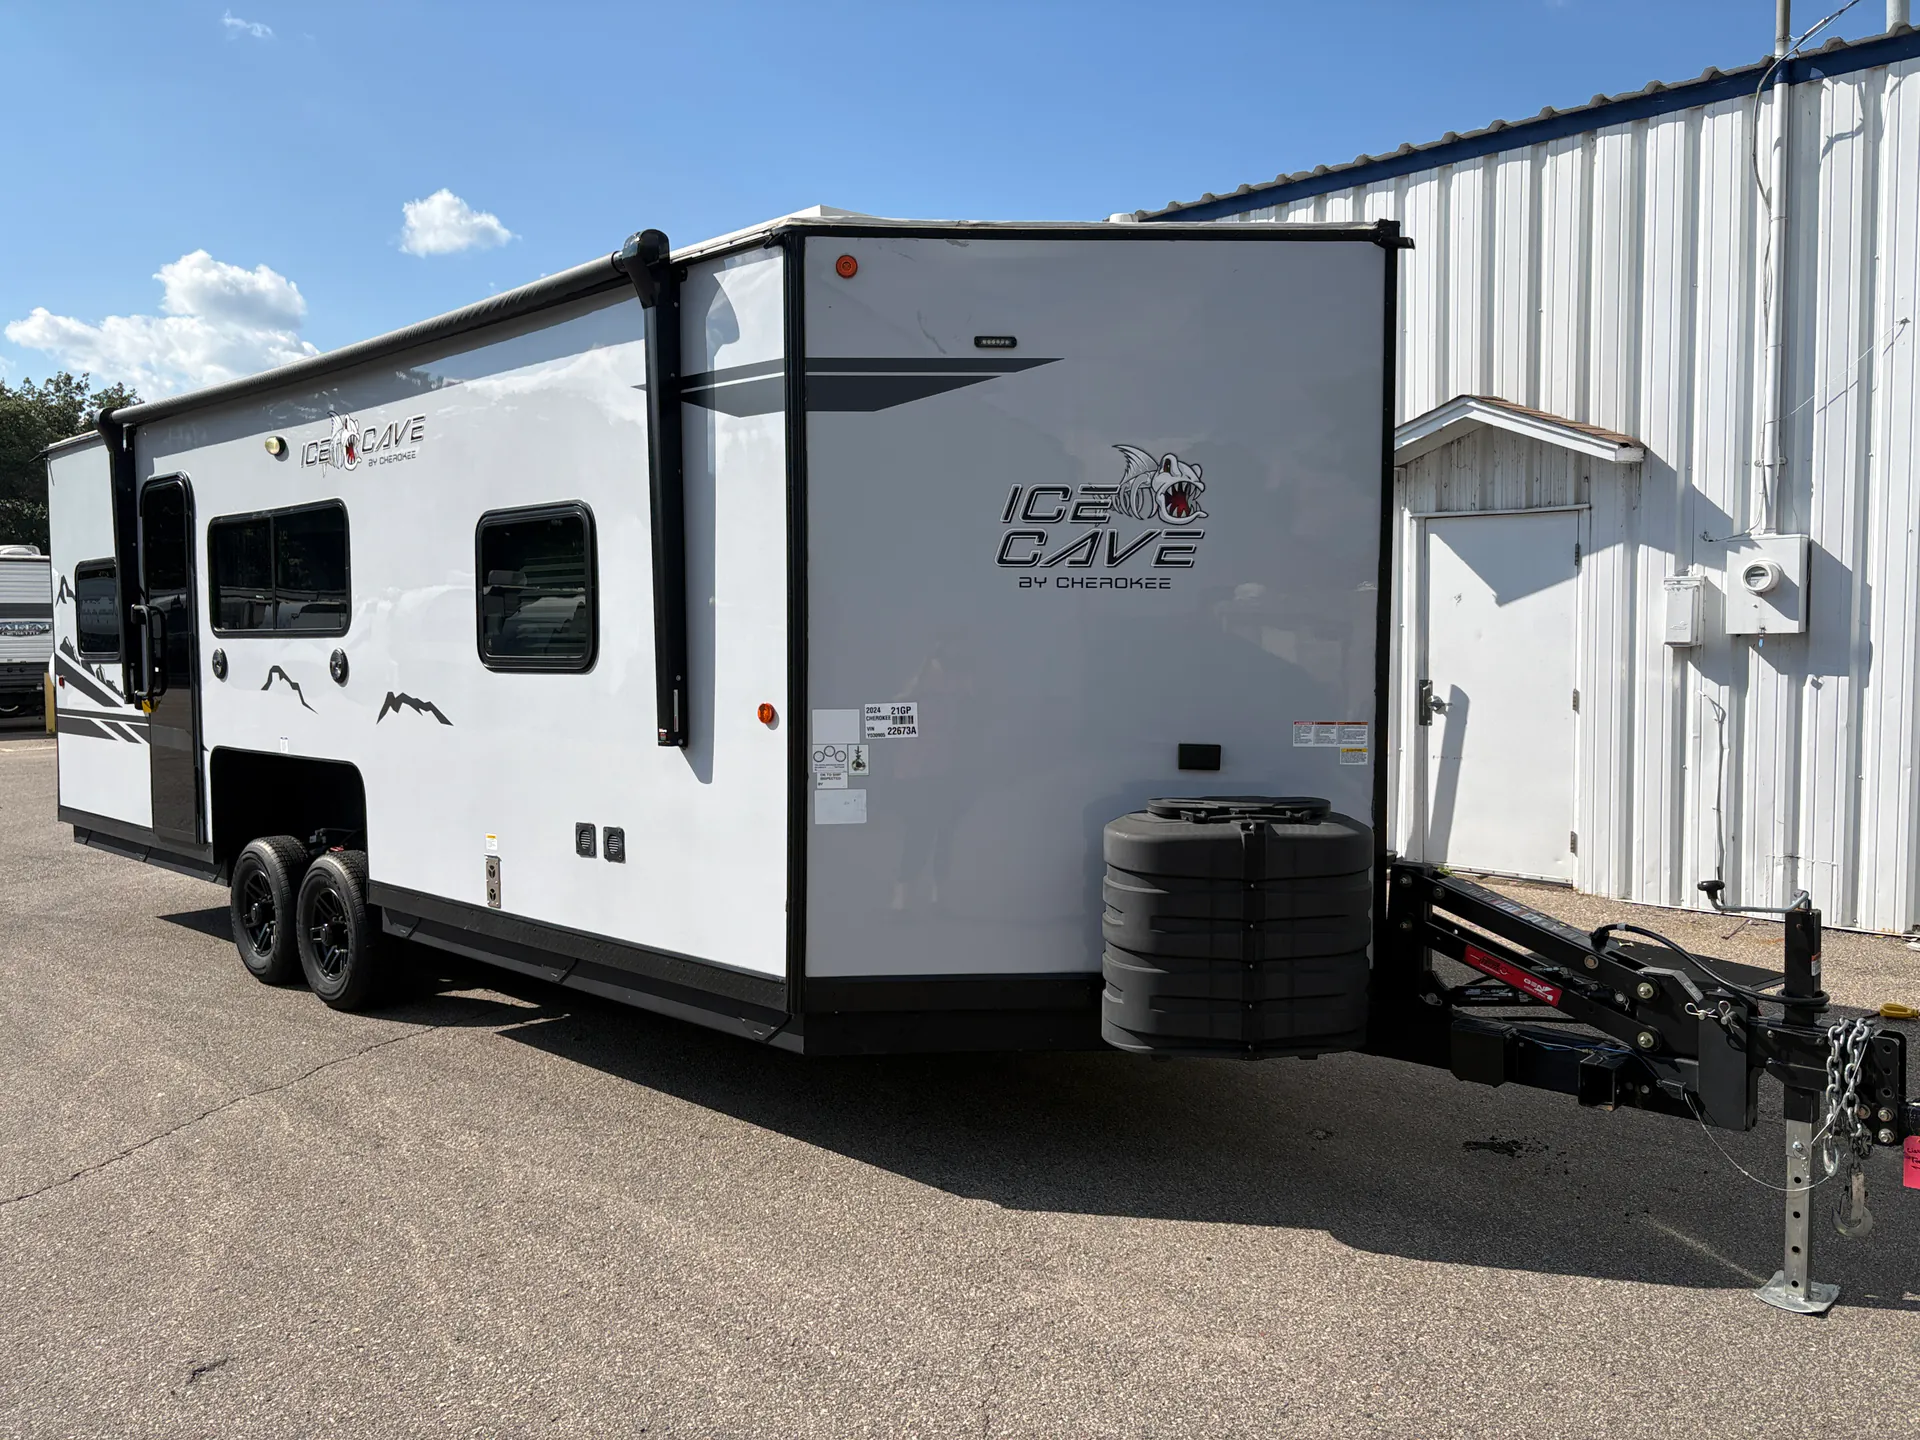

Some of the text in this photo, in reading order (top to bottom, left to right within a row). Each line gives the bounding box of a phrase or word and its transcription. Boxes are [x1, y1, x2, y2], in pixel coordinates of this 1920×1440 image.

[300, 413, 426, 468] ICE CAVE
[368, 450, 417, 467] BY CHEROKEE
[1000, 484, 1121, 523] ICE
[995, 528, 1204, 568] CAVE
[1019, 577, 1171, 589] BY CHEROKEE
[866, 706, 912, 715] 2024 21GP
[887, 726, 917, 736] 22673A
